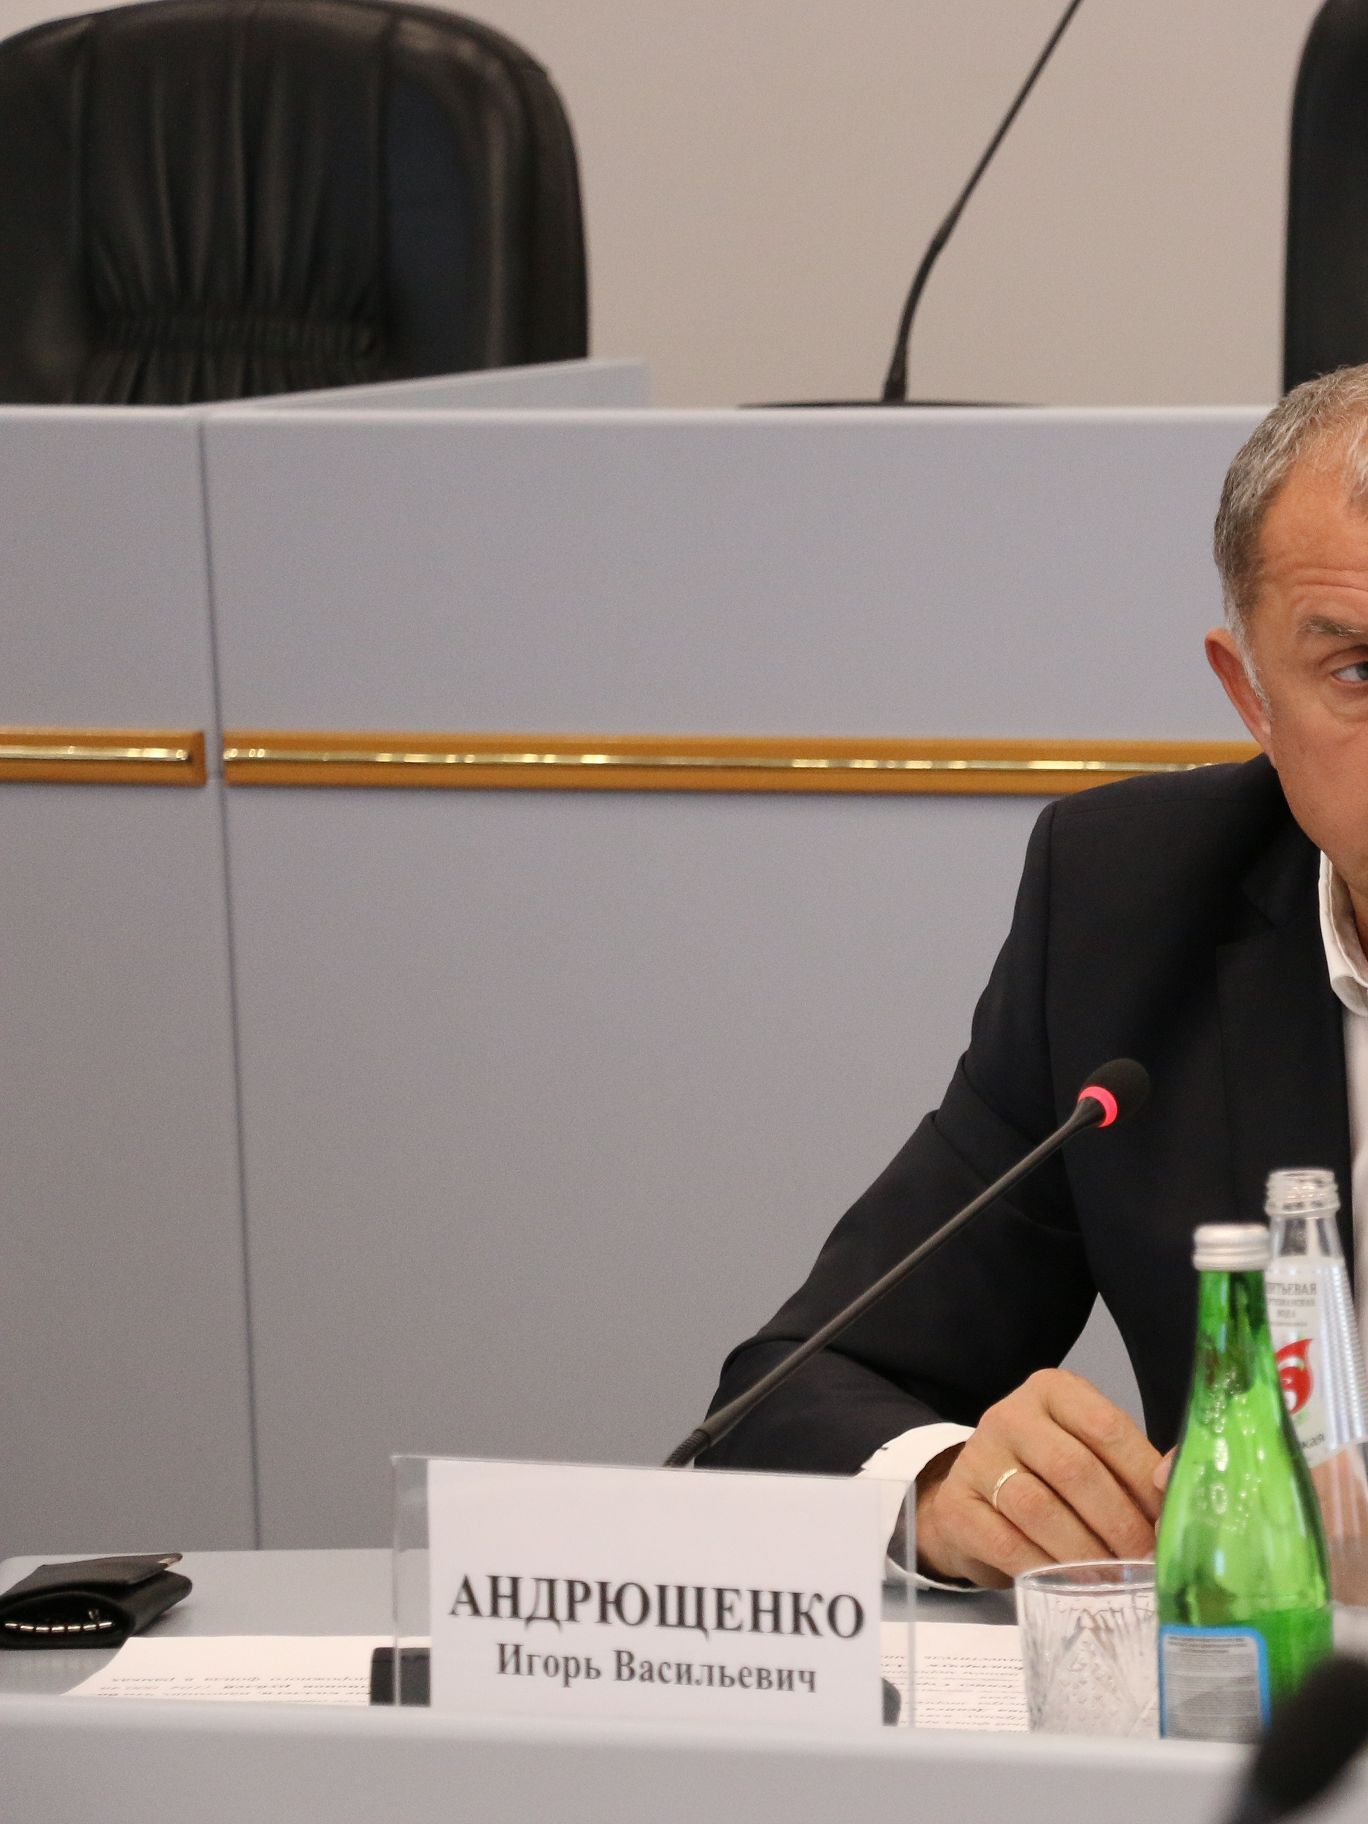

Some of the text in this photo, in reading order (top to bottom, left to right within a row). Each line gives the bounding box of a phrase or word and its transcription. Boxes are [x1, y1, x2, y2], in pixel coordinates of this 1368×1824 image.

[448, 1573, 866, 1643] АНДРЮЩЕНКО
[496, 1642, 818, 1694] Игорь Васильевич
